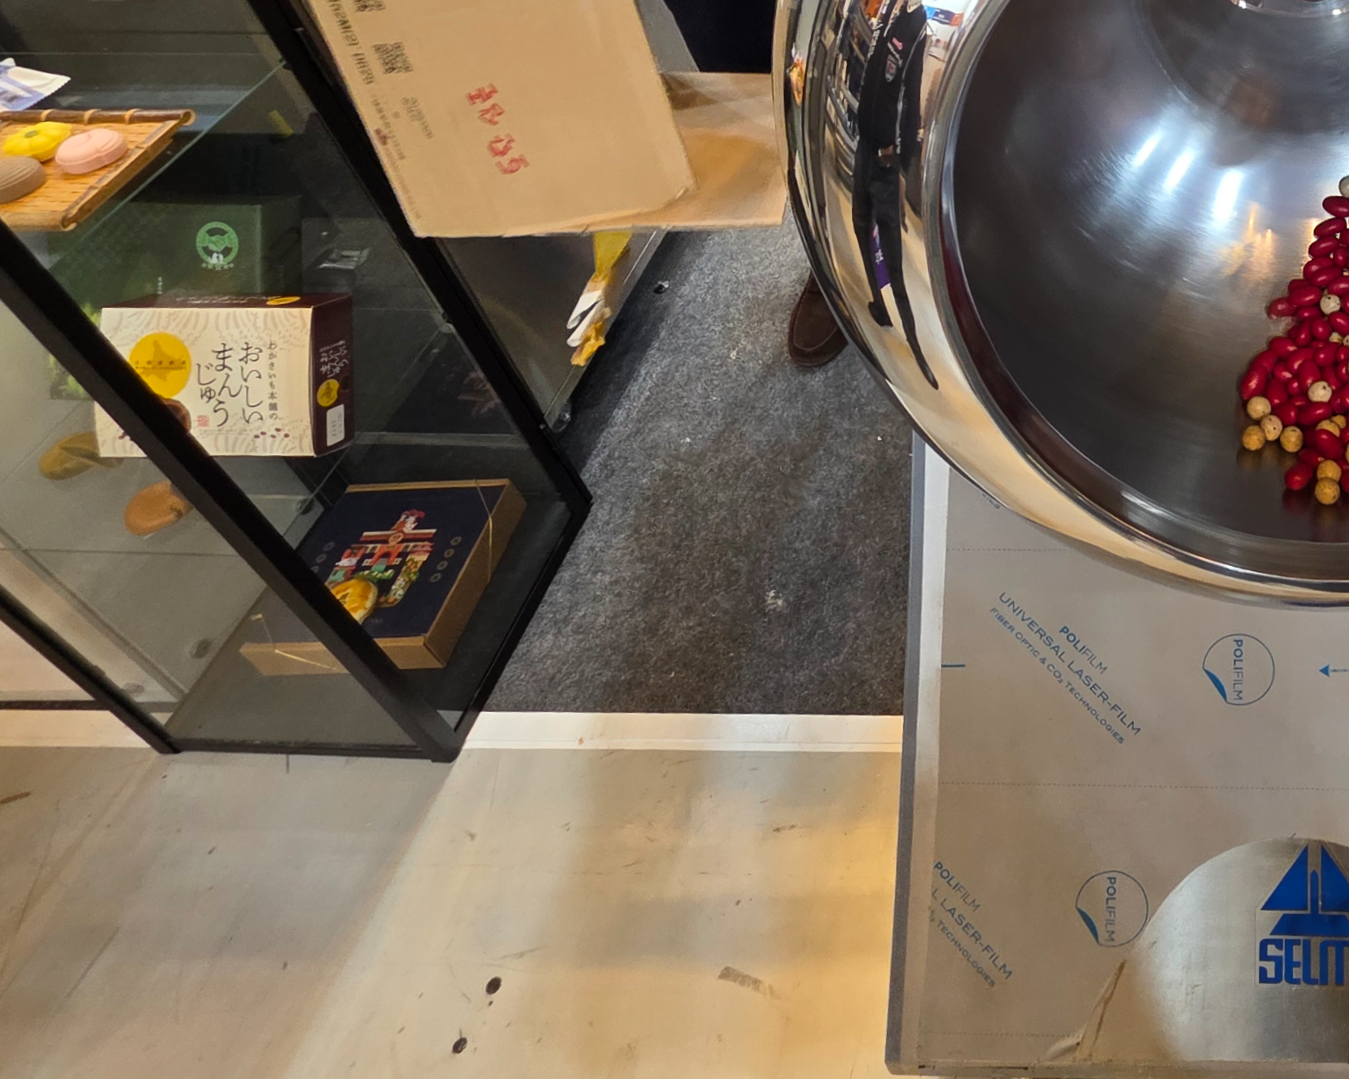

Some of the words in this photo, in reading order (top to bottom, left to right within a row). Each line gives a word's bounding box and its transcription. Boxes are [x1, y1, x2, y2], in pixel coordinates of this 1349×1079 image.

[237, 341, 264, 425] おいしい
[989, 606, 1016, 634] FIBER
[1014, 630, 1041, 659] OPTIC
[1038, 656, 1048, 666] &
[1064, 680, 1126, 745] TECHNOLOGIES
[998, 591, 1066, 664] UNIVERSAL
[1066, 660, 1142, 736] LASER-FILM
[1058, 625, 1109, 675] POLIFILM
[1232, 638, 1245, 702] POLIFILM
[932, 861, 982, 914] POLIFILM
[1105, 875, 1117, 943] POLIFILM
[936, 920, 997, 989] TECHNOLOGIES
[939, 898, 1014, 981] LASER-FILM
